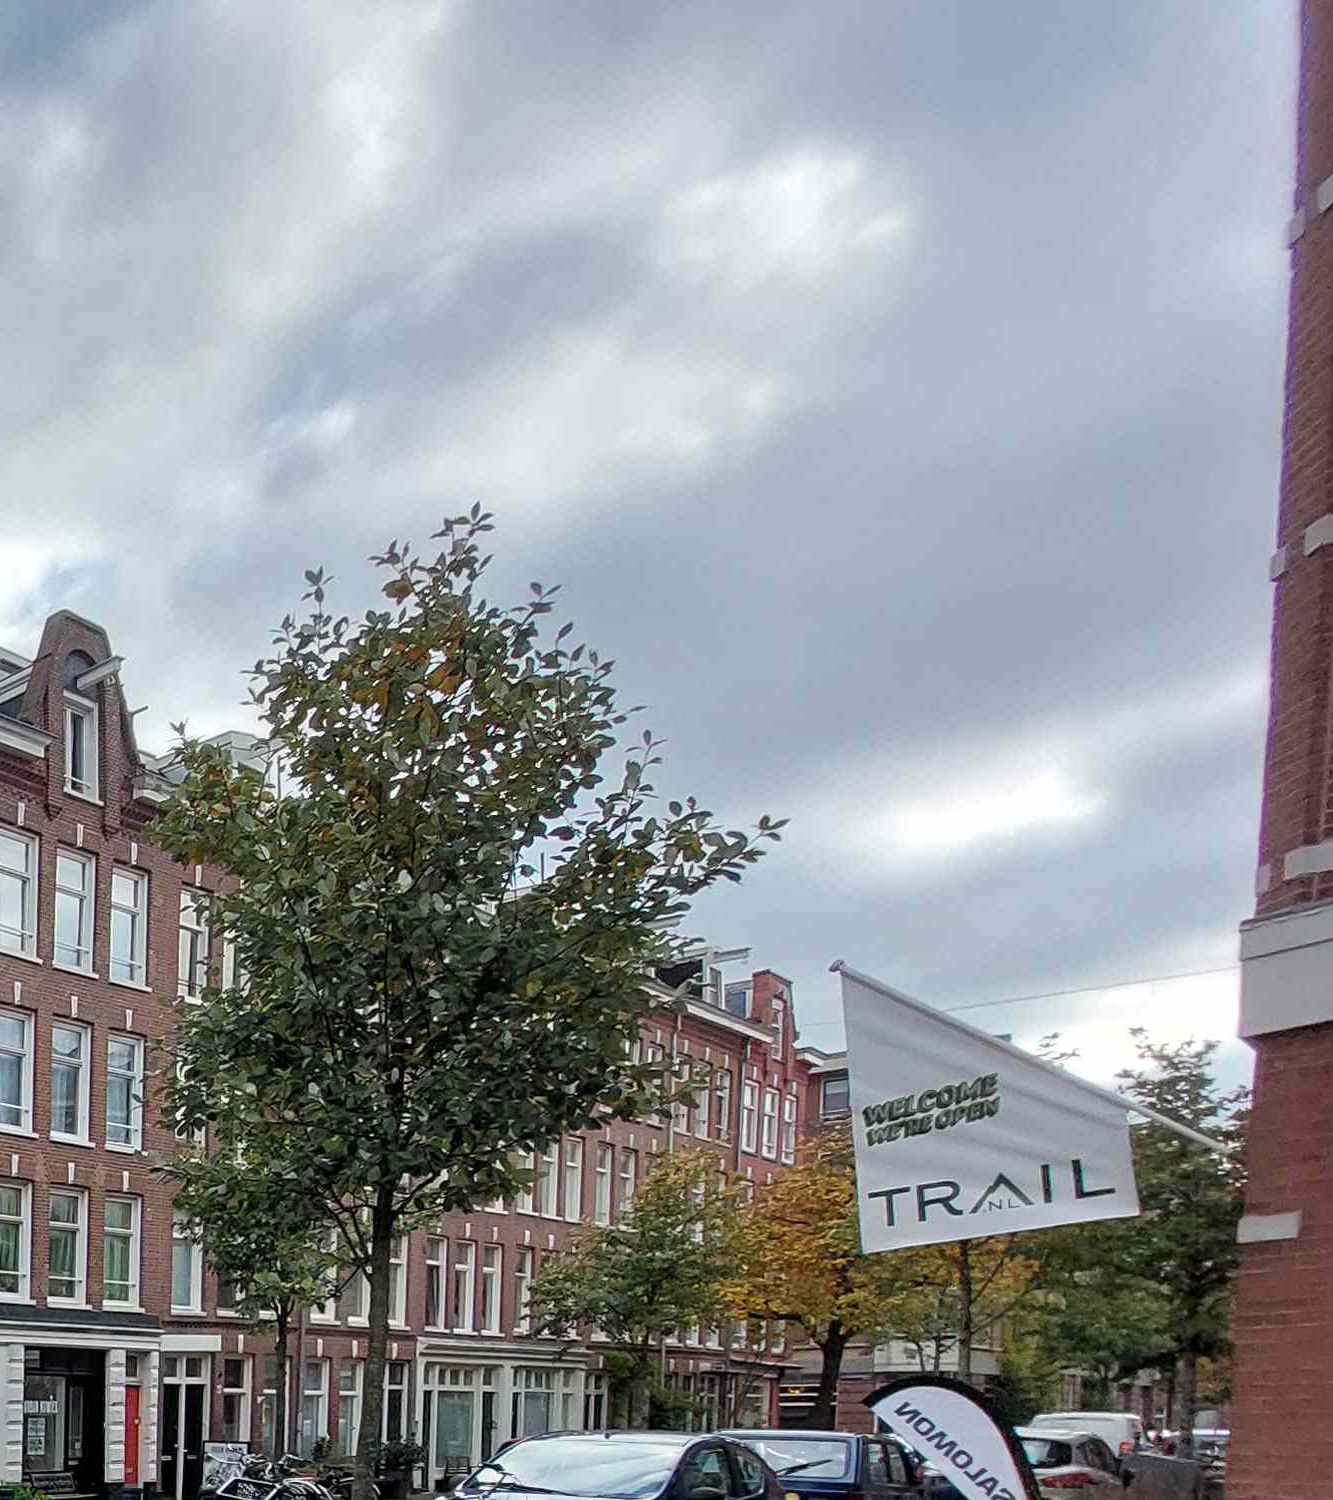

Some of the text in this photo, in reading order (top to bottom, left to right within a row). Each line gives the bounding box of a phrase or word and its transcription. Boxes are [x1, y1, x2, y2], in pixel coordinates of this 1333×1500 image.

[862, 1073, 998, 1127] WELCOME
[935, 1097, 1000, 1130] OPEN
[868, 1159, 1115, 1226] TRAIL
